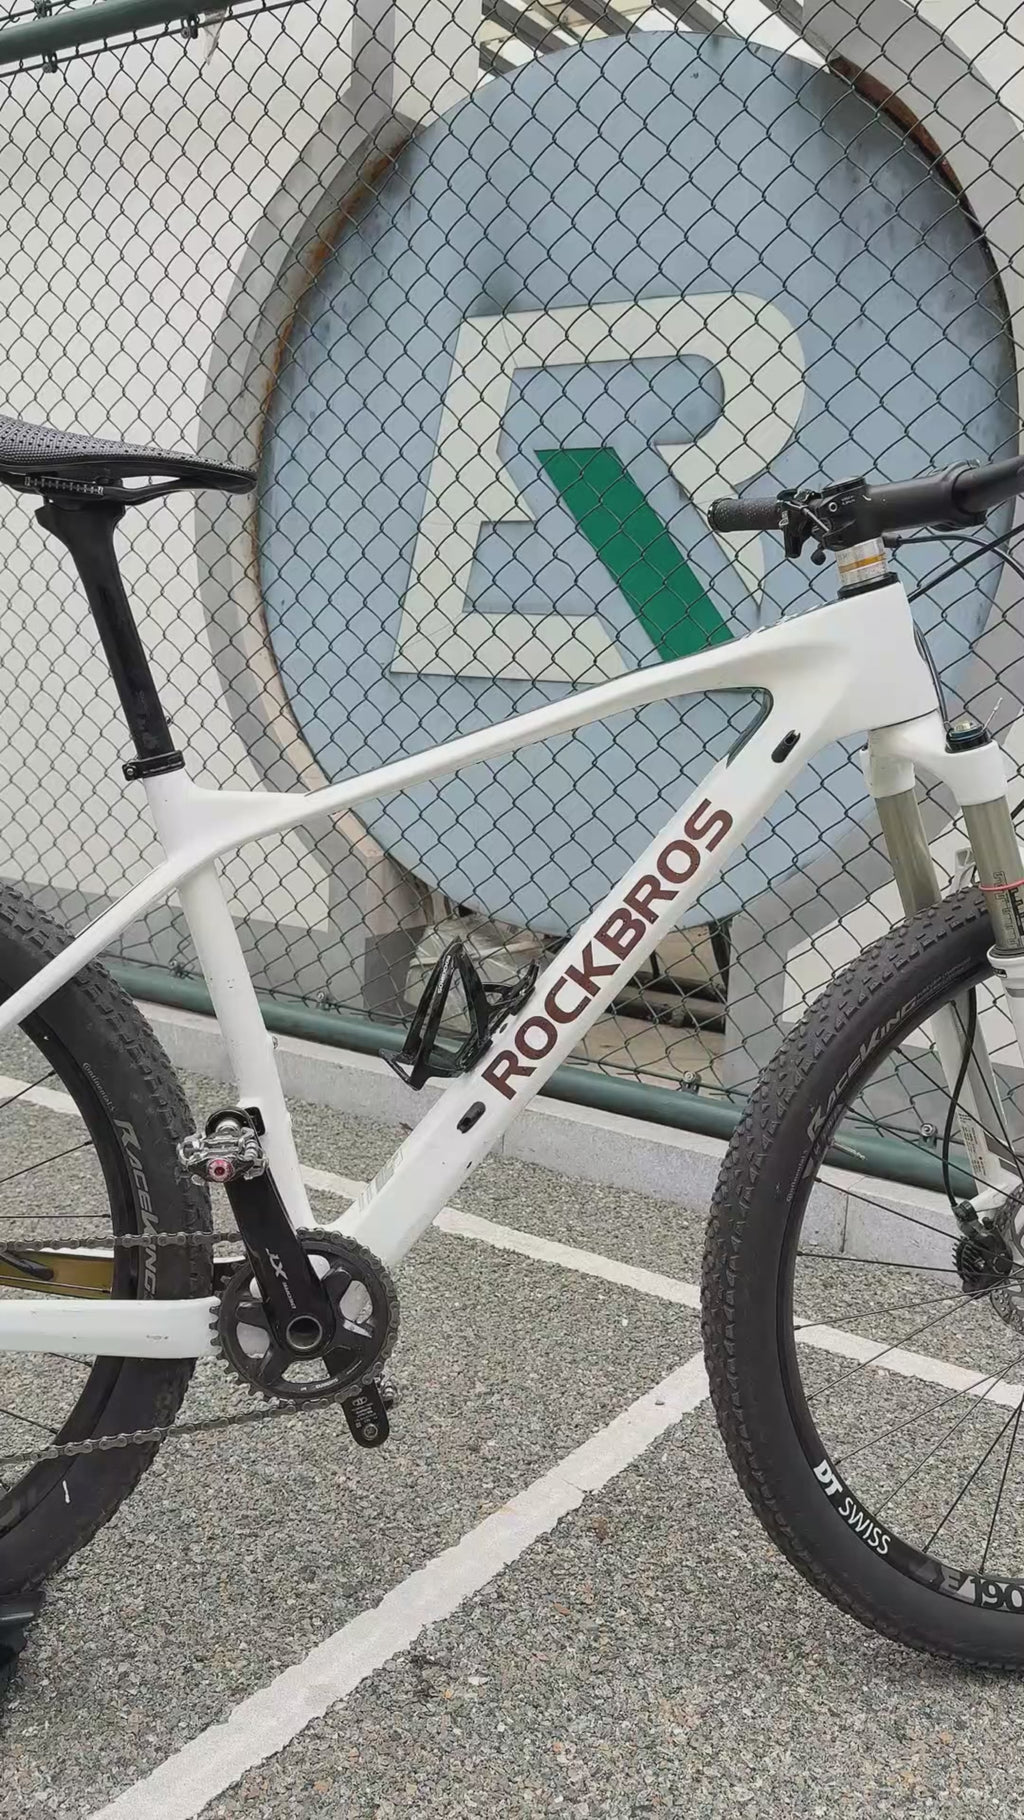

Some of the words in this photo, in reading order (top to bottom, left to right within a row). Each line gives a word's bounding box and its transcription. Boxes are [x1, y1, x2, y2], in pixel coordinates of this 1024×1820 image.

[481, 798, 734, 1100] ROCKBROS
[813, 1459, 843, 1496] DT
[838, 1497, 891, 1554] SWISS
